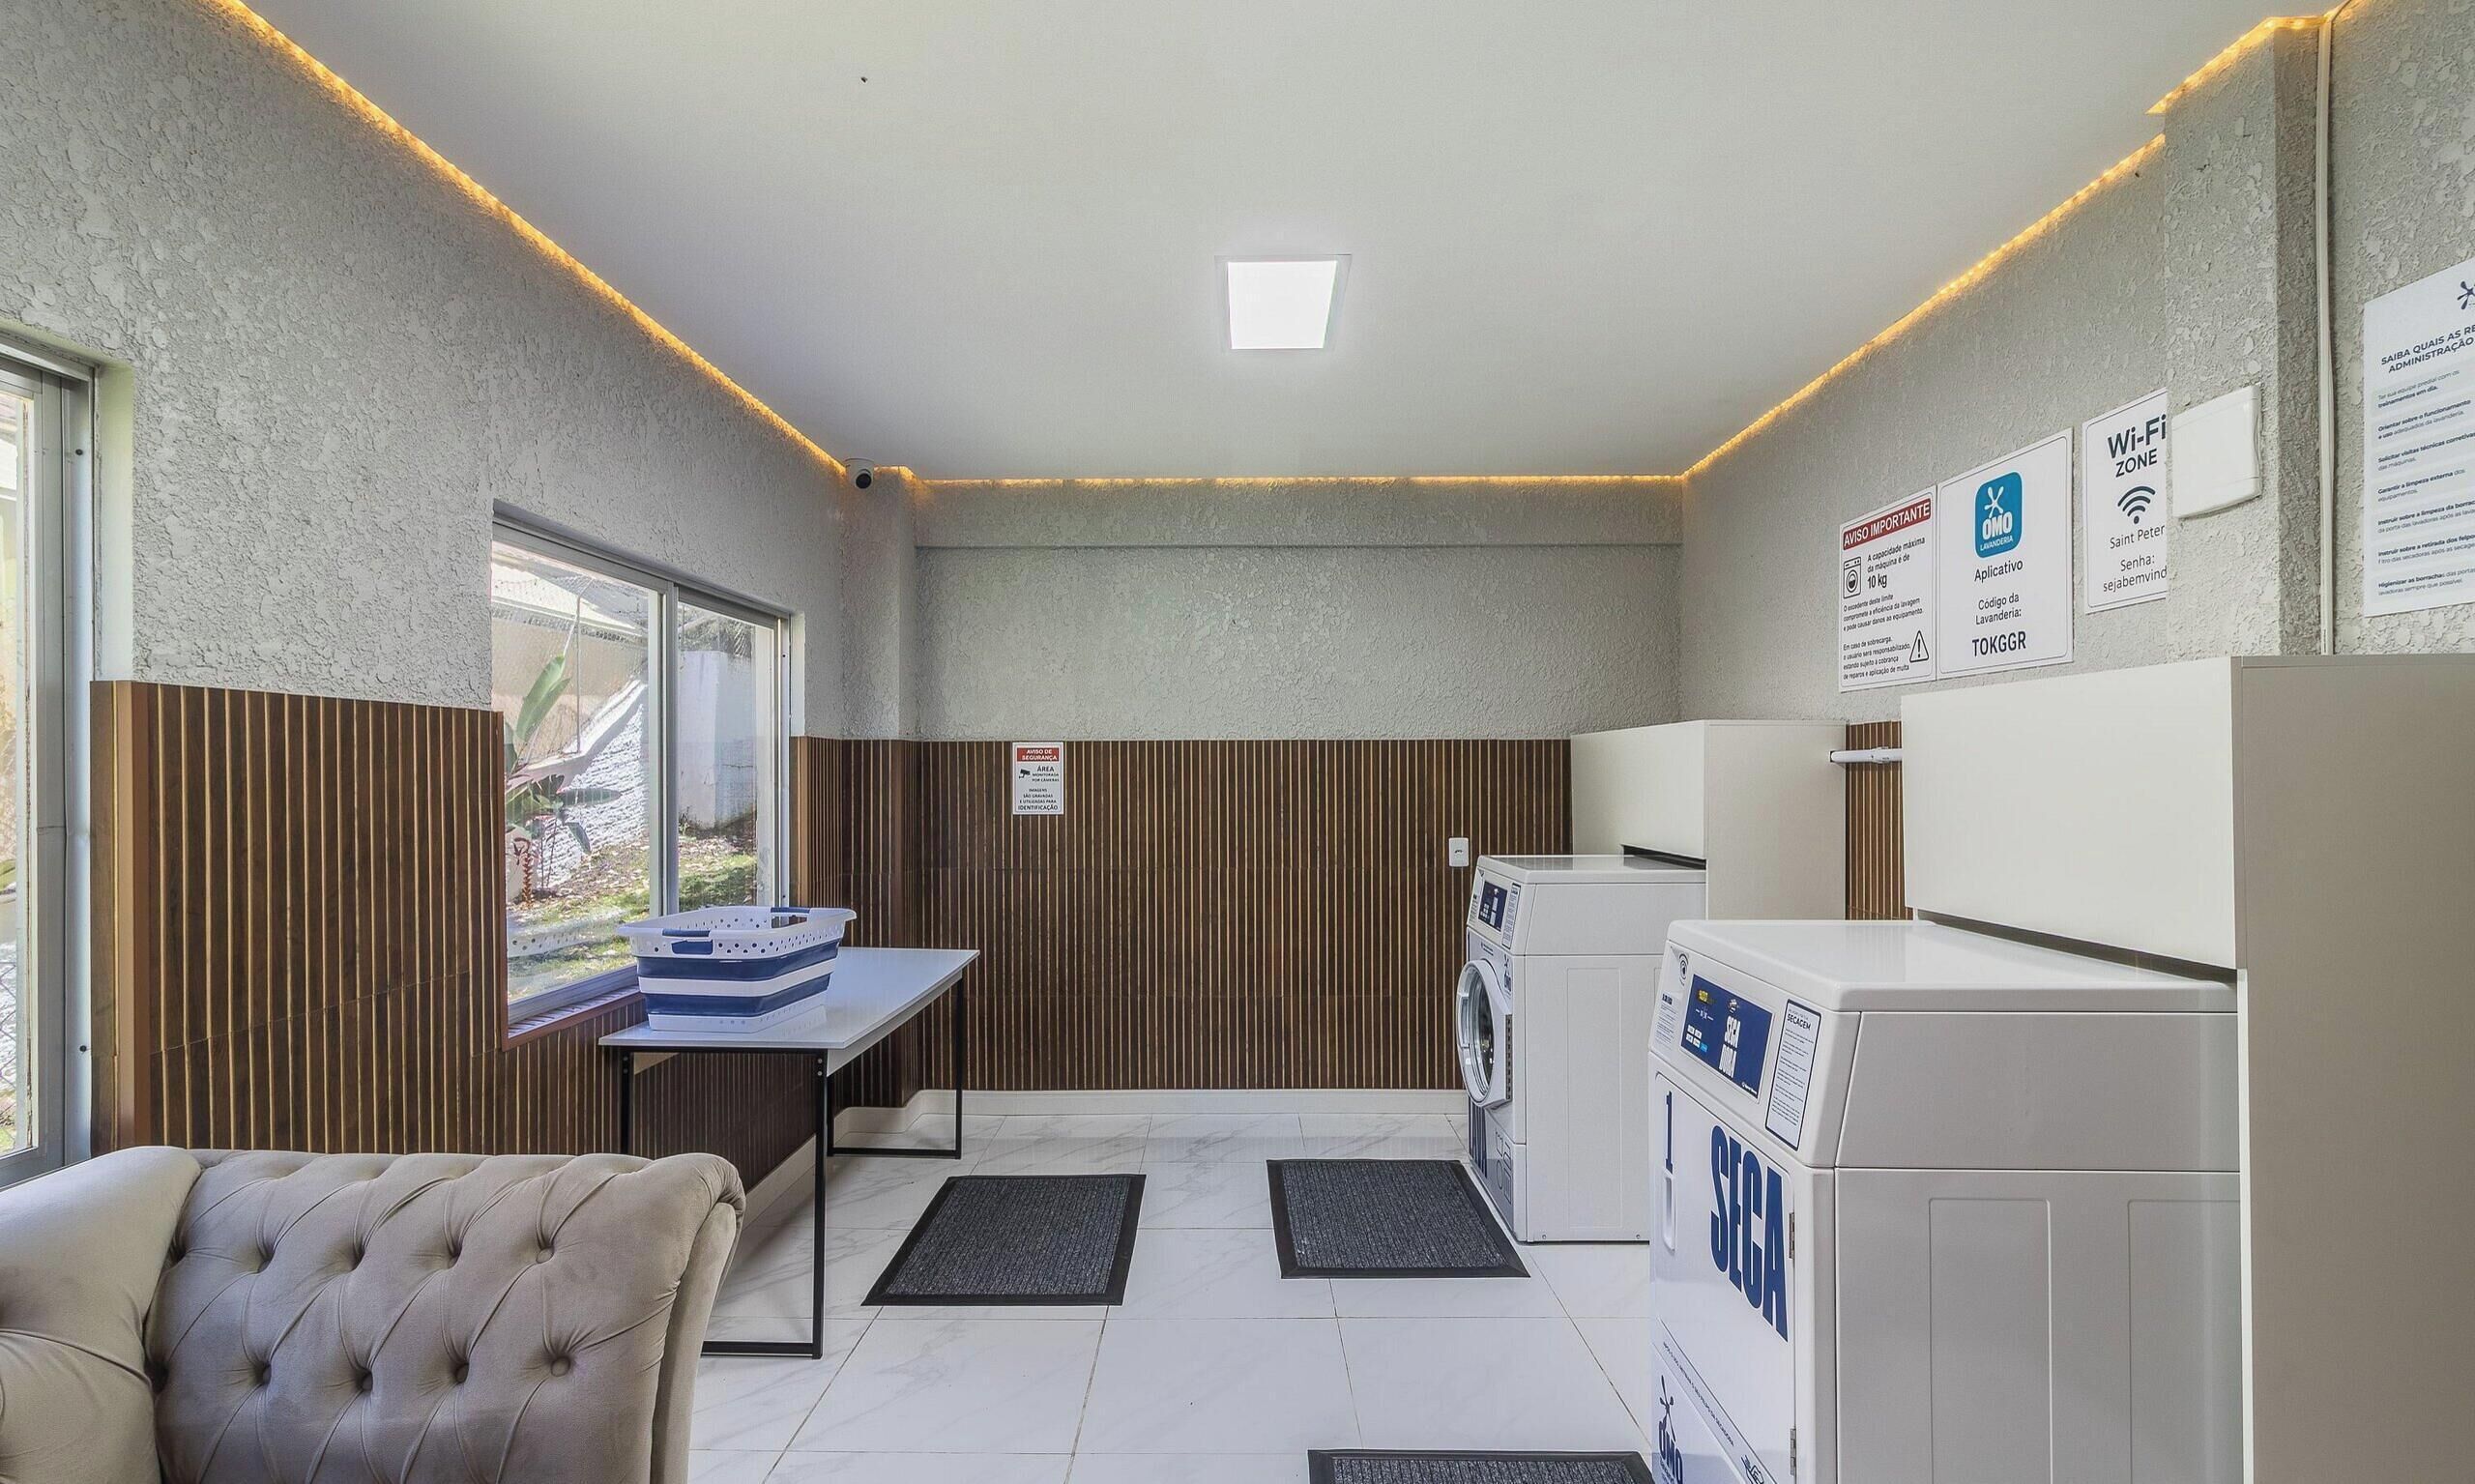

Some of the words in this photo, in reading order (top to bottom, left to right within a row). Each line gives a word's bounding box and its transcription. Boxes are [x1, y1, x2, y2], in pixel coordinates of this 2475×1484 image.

[2381, 349, 2410, 364] SAIBA
[2413, 335, 2444, 353] QUAIS
[2447, 330, 2460, 341] AS
[2389, 337, 2473, 372] ADMINISTRAÇÃO
[2378, 393, 2415, 408] treinamentos
[2378, 422, 2400, 431] Orientar
[2424, 400, 2470, 417] funcionamento
[2108, 414, 2166, 459] Wi-Fi
[2115, 448, 2157, 478] ZONE
[2378, 453, 2400, 462] Solicitar
[2430, 472, 2453, 480] externa
[1844, 526, 1869, 547] AVISO
[1870, 502, 1930, 537] IMPORTANTE
[1983, 511, 2013, 539] OMO
[1980, 536, 2013, 551] LAVANDERIA
[2110, 534, 2135, 549] Saint
[2137, 525, 2166, 541] Peter
[1873, 544, 1901, 560] capacidade
[1903, 538, 1925, 549] máxima
[1875, 559, 1897, 569] máquina
[1903, 553, 1909, 562] de
[1974, 561, 2024, 582] Aplicativo
[2120, 554, 2155, 571] Senha:
[1867, 575, 1876, 588] 10
[1878, 573, 1887, 588] kg
[1978, 597, 2007, 610] Código
[2008, 593, 2020, 603] da
[1975, 607, 2022, 626] Lavanderia:
[1972, 630, 2026, 657] TOKGGR
[1788, 1013, 1811, 1030] SECAGEM
[1666, 1091, 1674, 1174] 1
[1710, 1125, 1788, 1342] SECA
